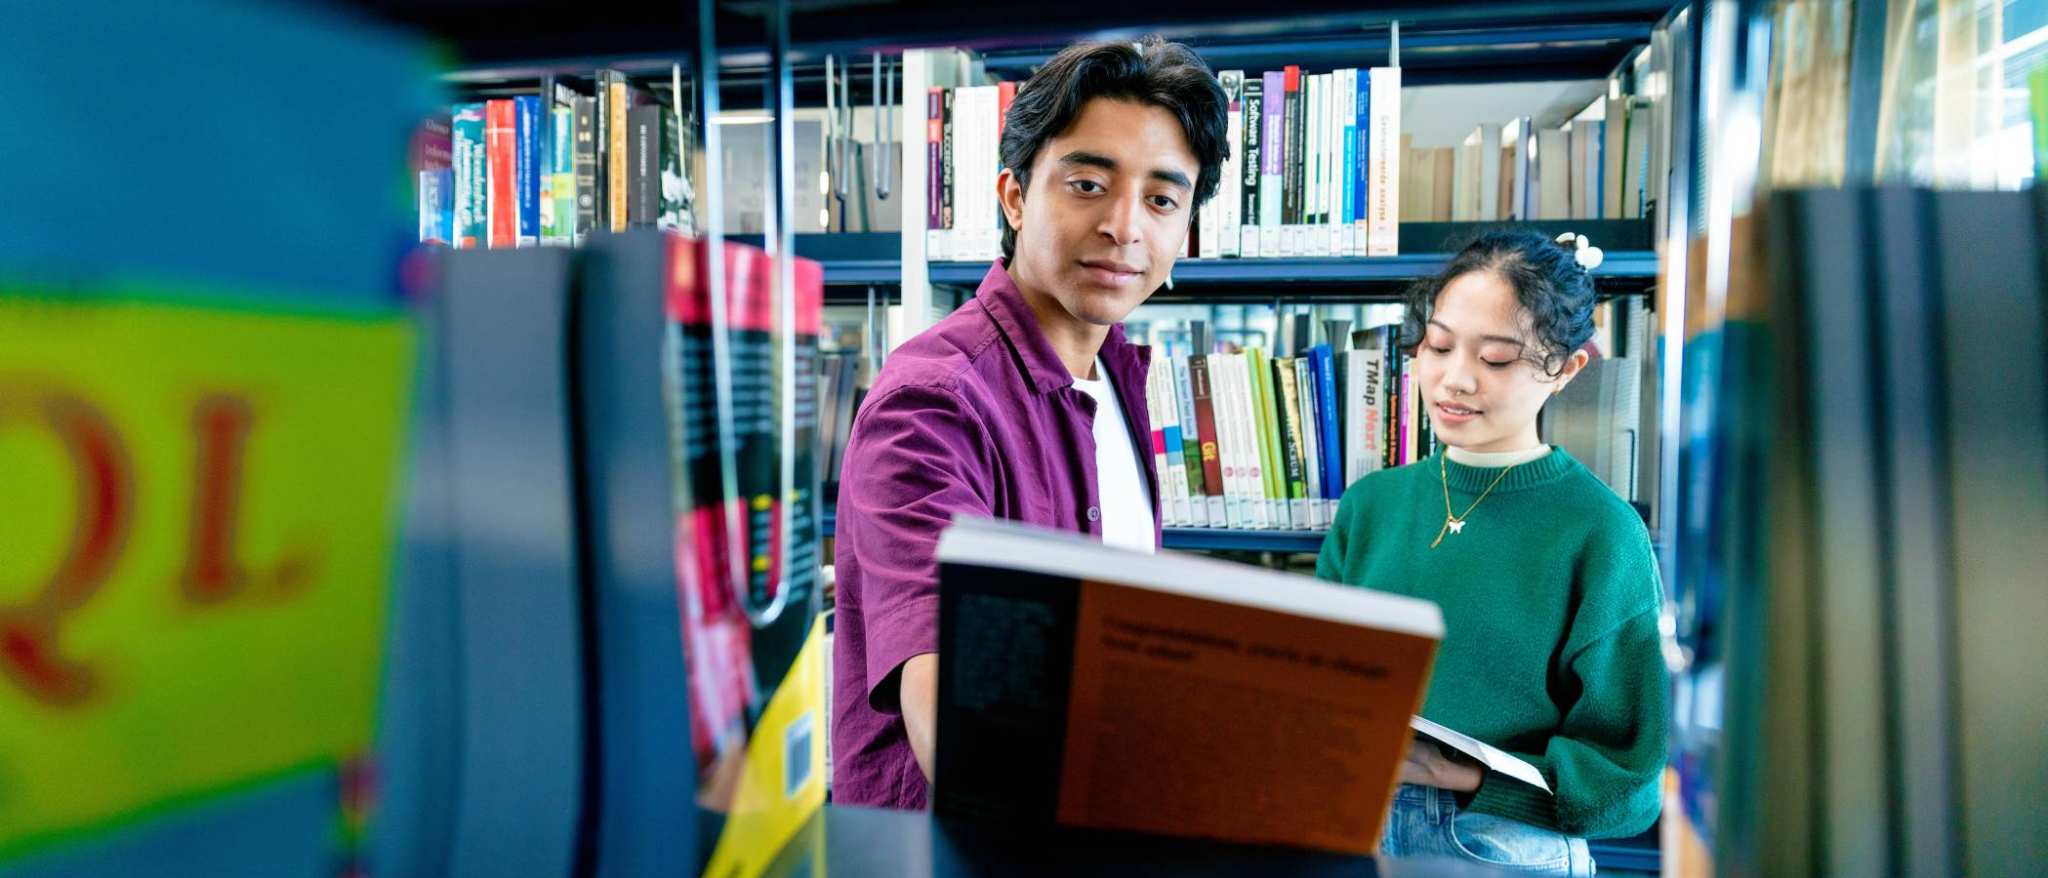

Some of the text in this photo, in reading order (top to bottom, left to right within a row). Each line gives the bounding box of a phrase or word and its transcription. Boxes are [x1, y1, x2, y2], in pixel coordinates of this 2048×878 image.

[1248, 98, 1260, 146] Software
[943, 123, 952, 184] SUCCEEDING
[1244, 149, 1258, 186] Testing
[1363, 359, 1379, 449] TMap Next
[1201, 441, 1216, 462] Git
